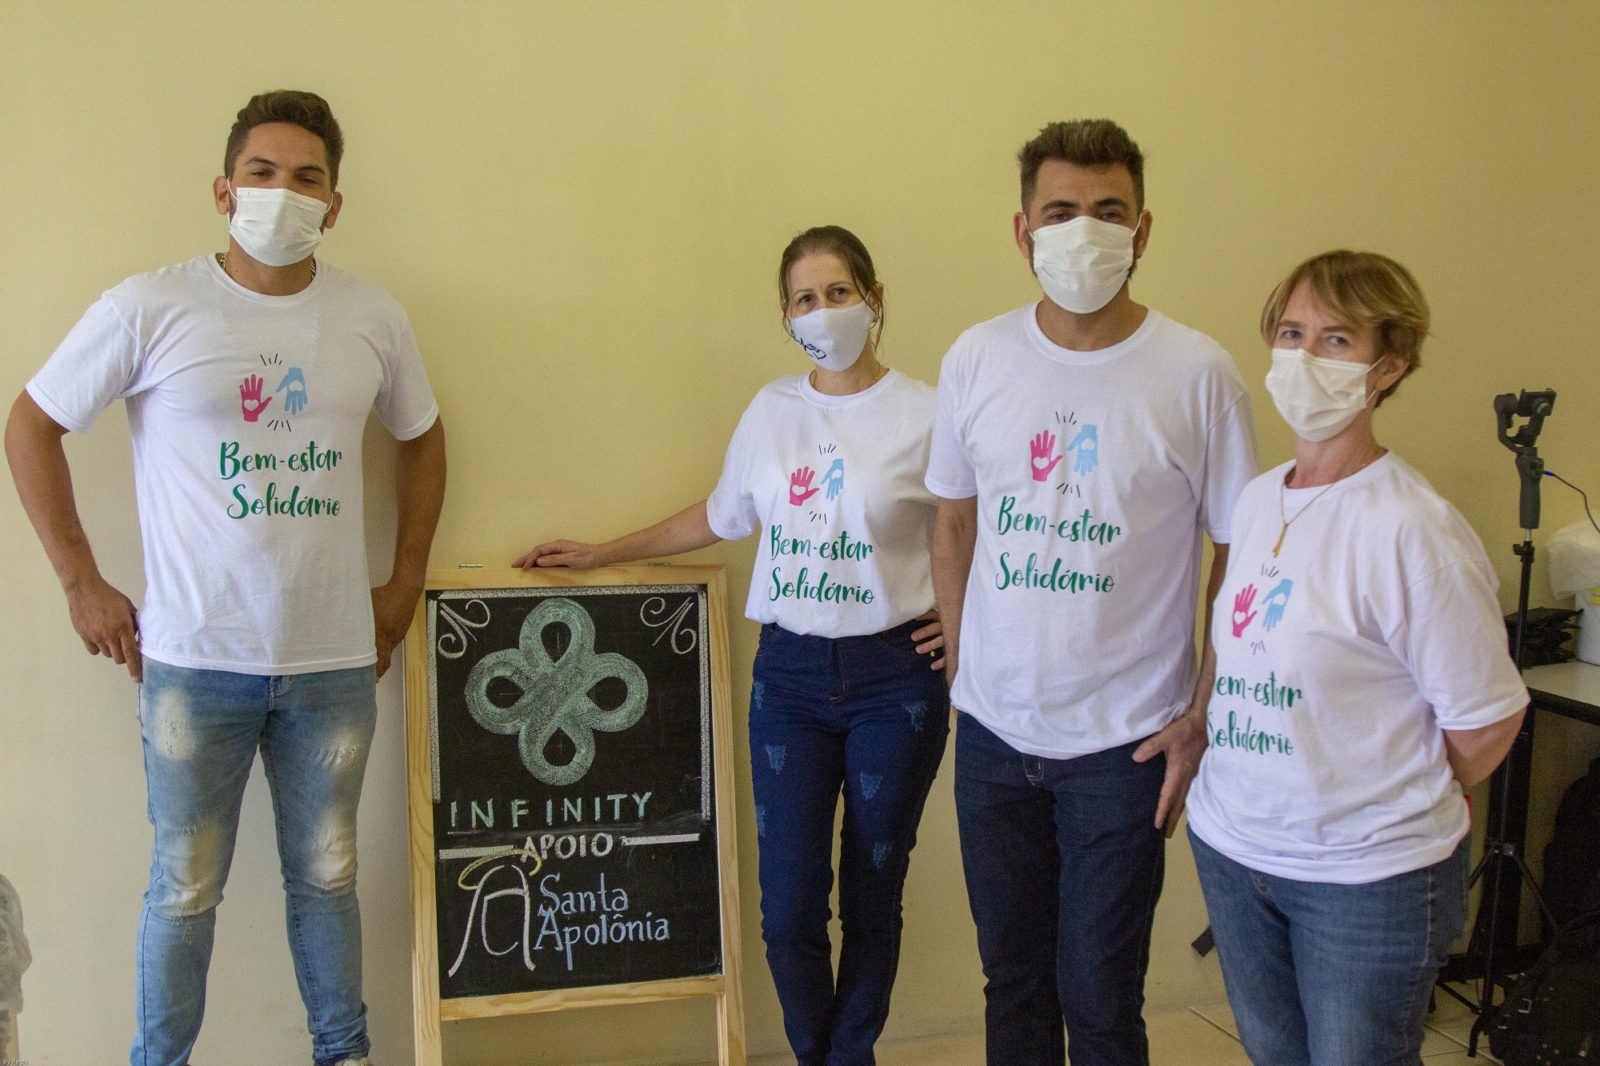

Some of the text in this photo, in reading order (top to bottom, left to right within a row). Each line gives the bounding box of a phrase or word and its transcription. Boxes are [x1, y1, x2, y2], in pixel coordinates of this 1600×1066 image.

[219, 440, 343, 481] Bem-estar
[226, 482, 342, 520] Solidário
[996, 495, 1122, 546] Bem-estar
[770, 524, 874, 562] Bem-estar
[768, 566, 875, 605] Solidário
[995, 551, 1116, 594] Solidário
[450, 791, 652, 829] INFINITY
[521, 832, 614, 863] APOIO
[539, 872, 630, 918] Santa
[532, 906, 671, 972] Apolônia
